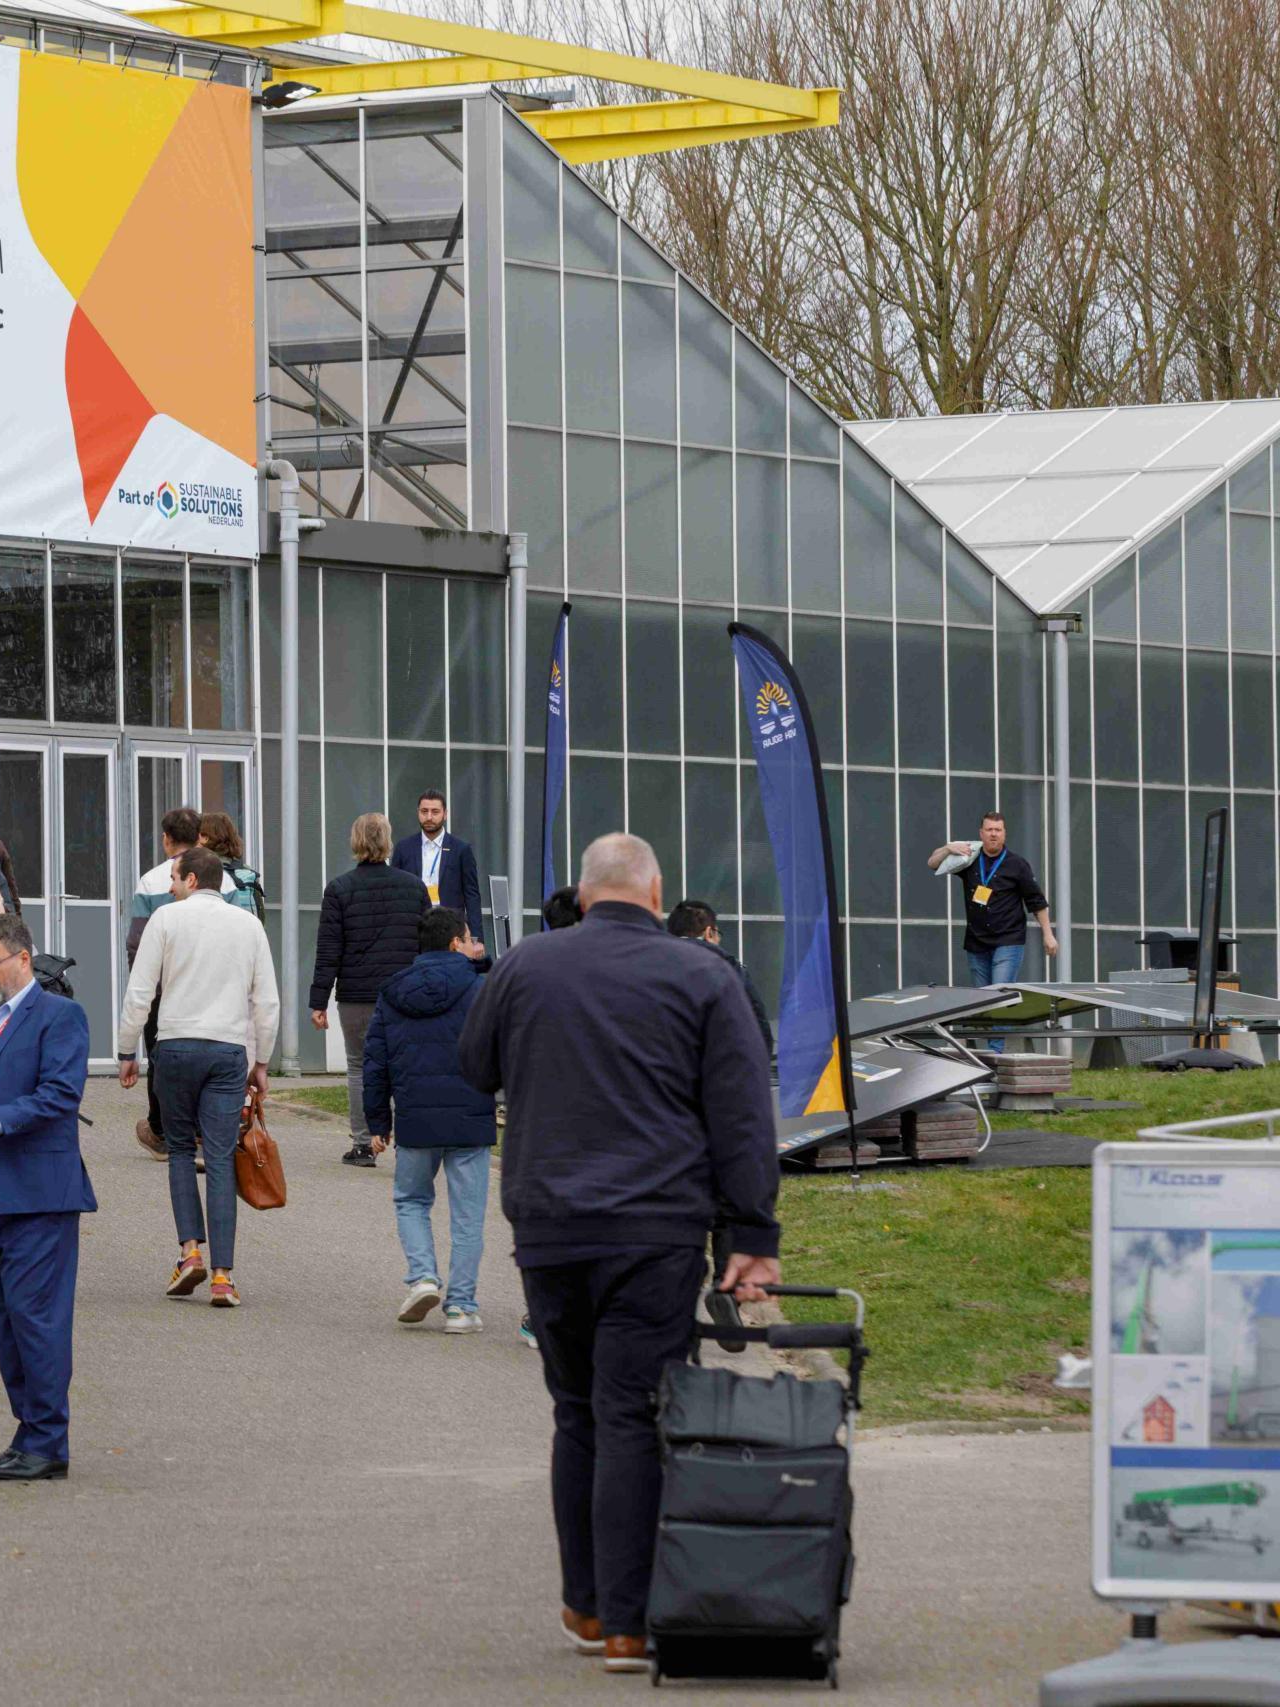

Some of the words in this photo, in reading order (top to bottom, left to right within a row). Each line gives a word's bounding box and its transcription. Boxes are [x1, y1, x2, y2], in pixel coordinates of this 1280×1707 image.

[119, 489, 140, 504] Part
[143, 491, 154, 505] of
[179, 483, 242, 501] SUSTAINABLE
[180, 498, 243, 517] SOLUTIONS
[208, 515, 243, 527] NEDERLAND
